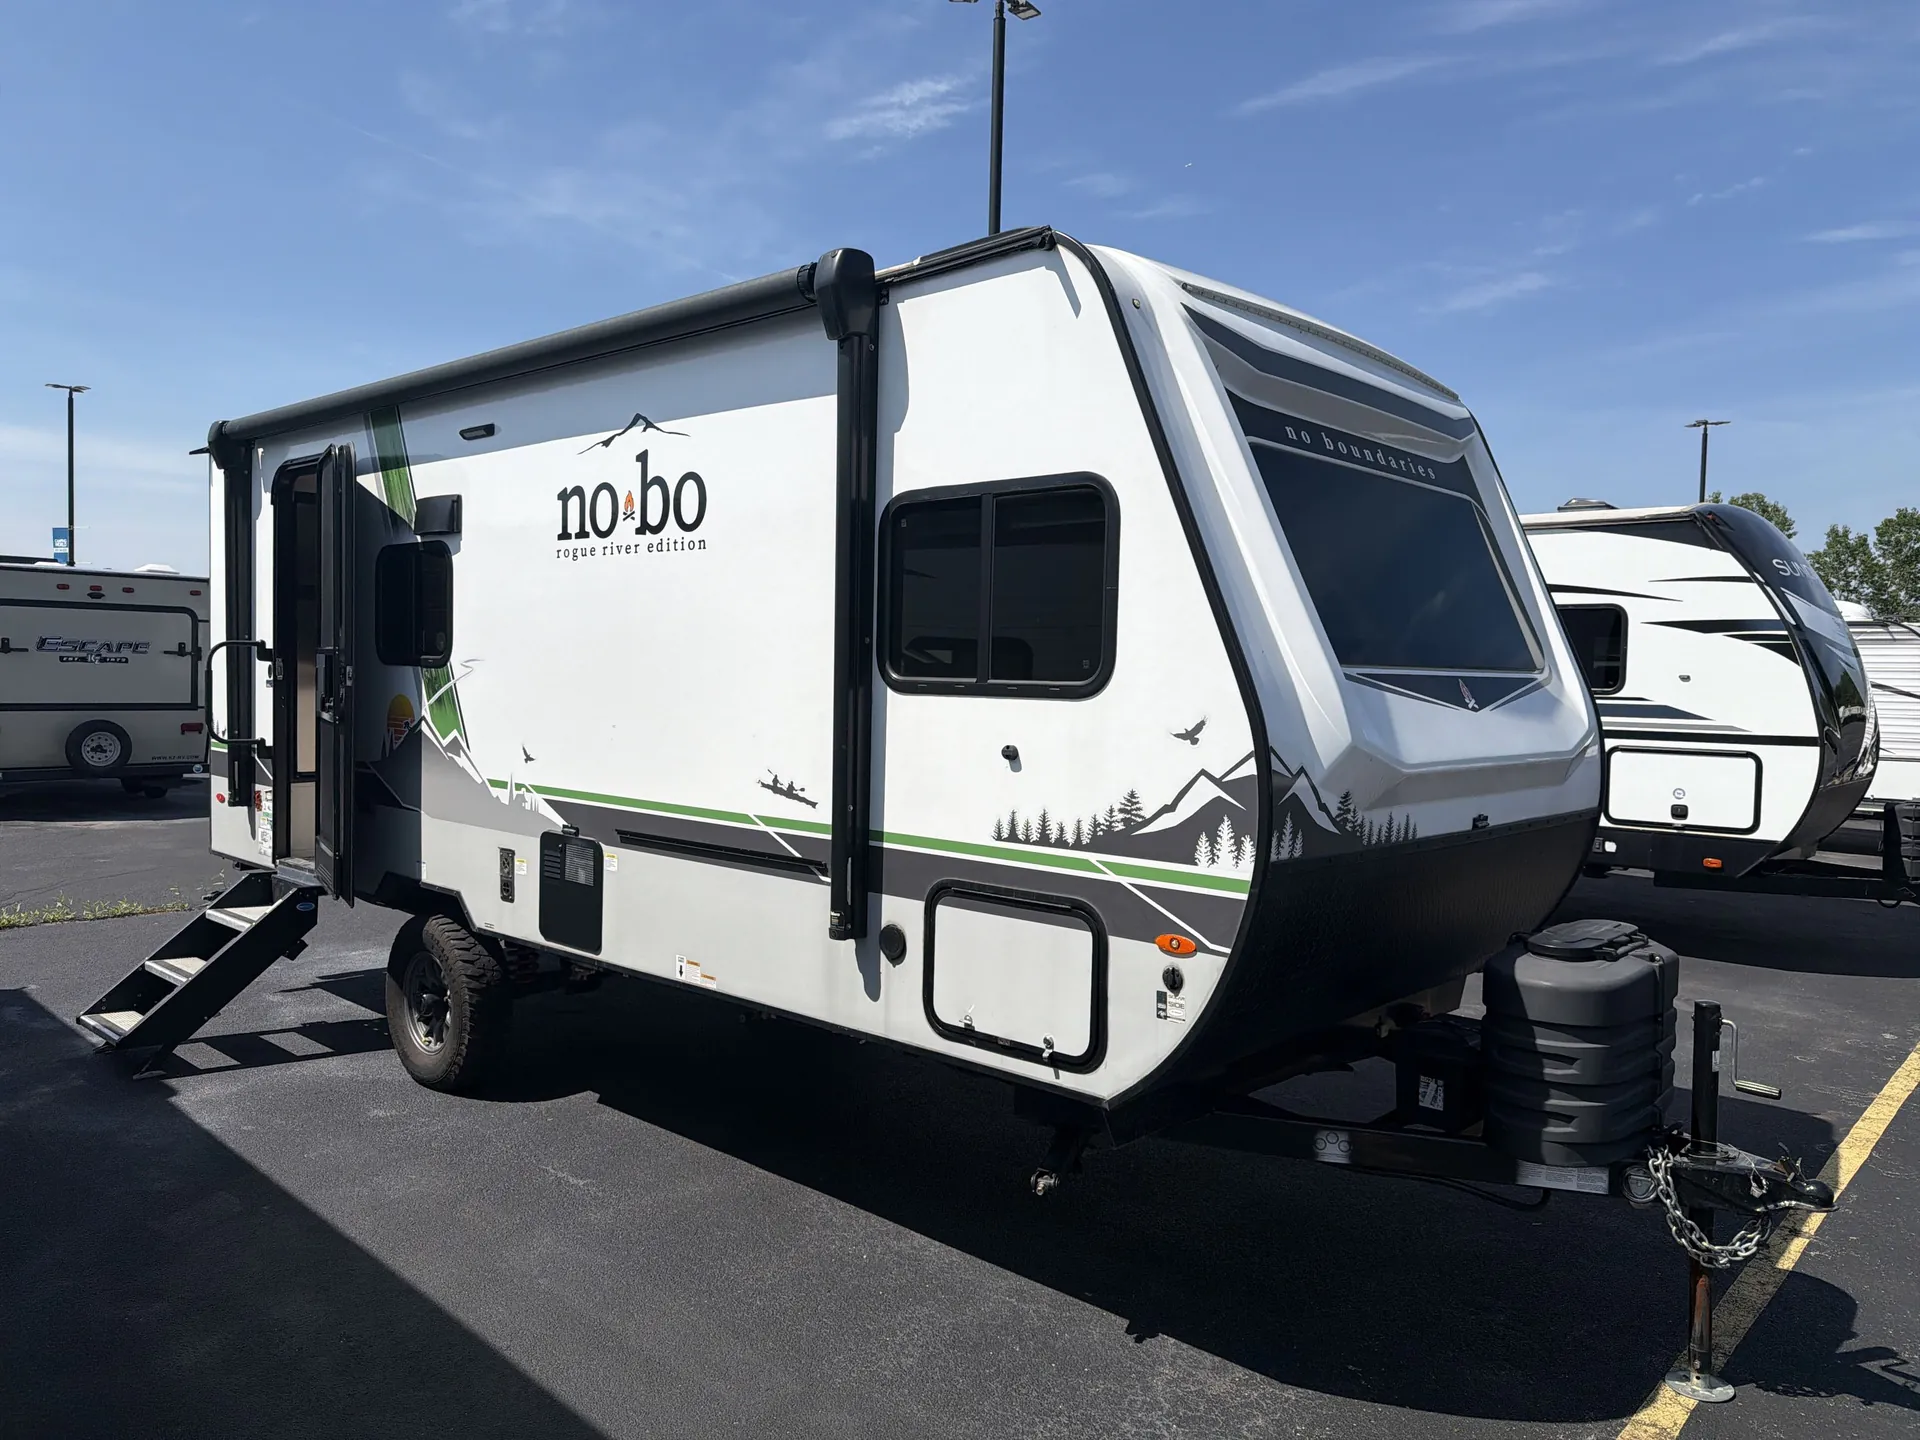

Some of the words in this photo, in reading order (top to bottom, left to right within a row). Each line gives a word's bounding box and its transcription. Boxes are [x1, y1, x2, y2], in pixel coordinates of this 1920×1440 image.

[1285, 425, 1311, 444] no
[1321, 432, 1436, 480] boundaries
[556, 546, 596, 561] rogue
[602, 541, 640, 556] river
[647, 536, 707, 553] edition
